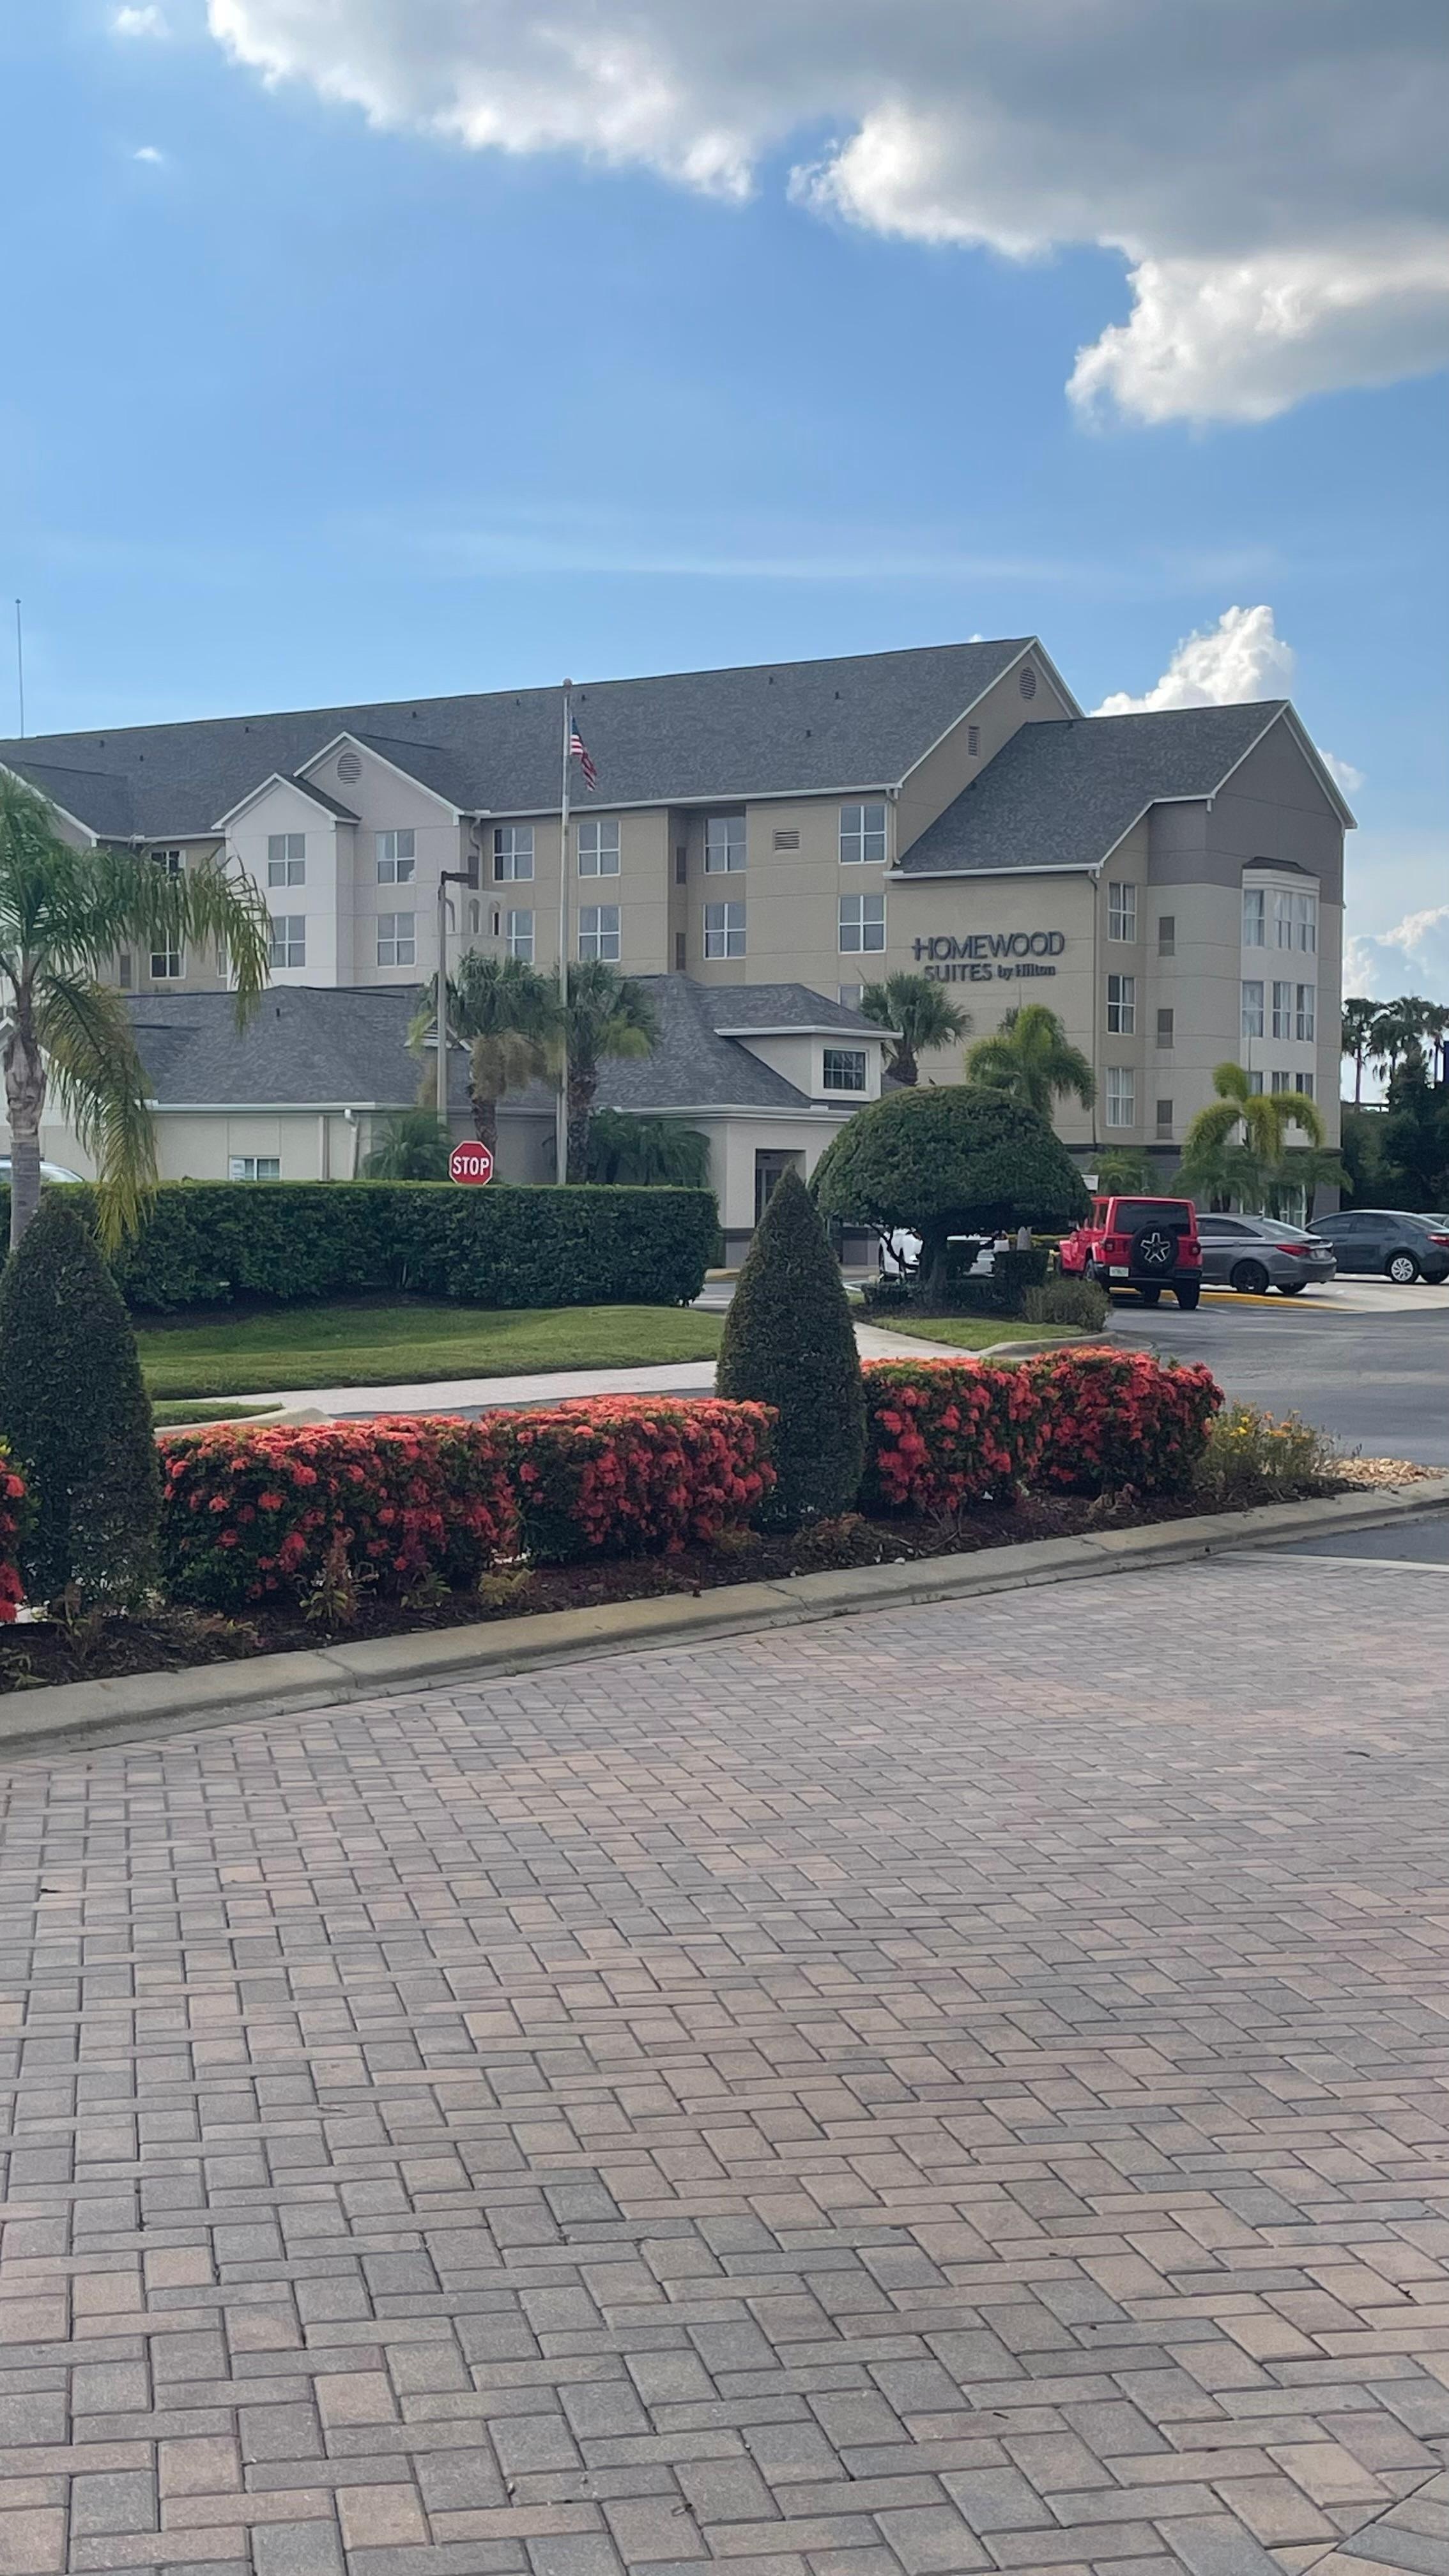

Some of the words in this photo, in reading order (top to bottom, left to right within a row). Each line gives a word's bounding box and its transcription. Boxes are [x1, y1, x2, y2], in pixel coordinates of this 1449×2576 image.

[912, 931, 1065, 961] HOMEWOOD
[924, 963, 992, 982] SUITES
[997, 964, 1013, 981] by
[1015, 963, 1056, 977] Hilton
[452, 1156, 489, 1176] STOP
